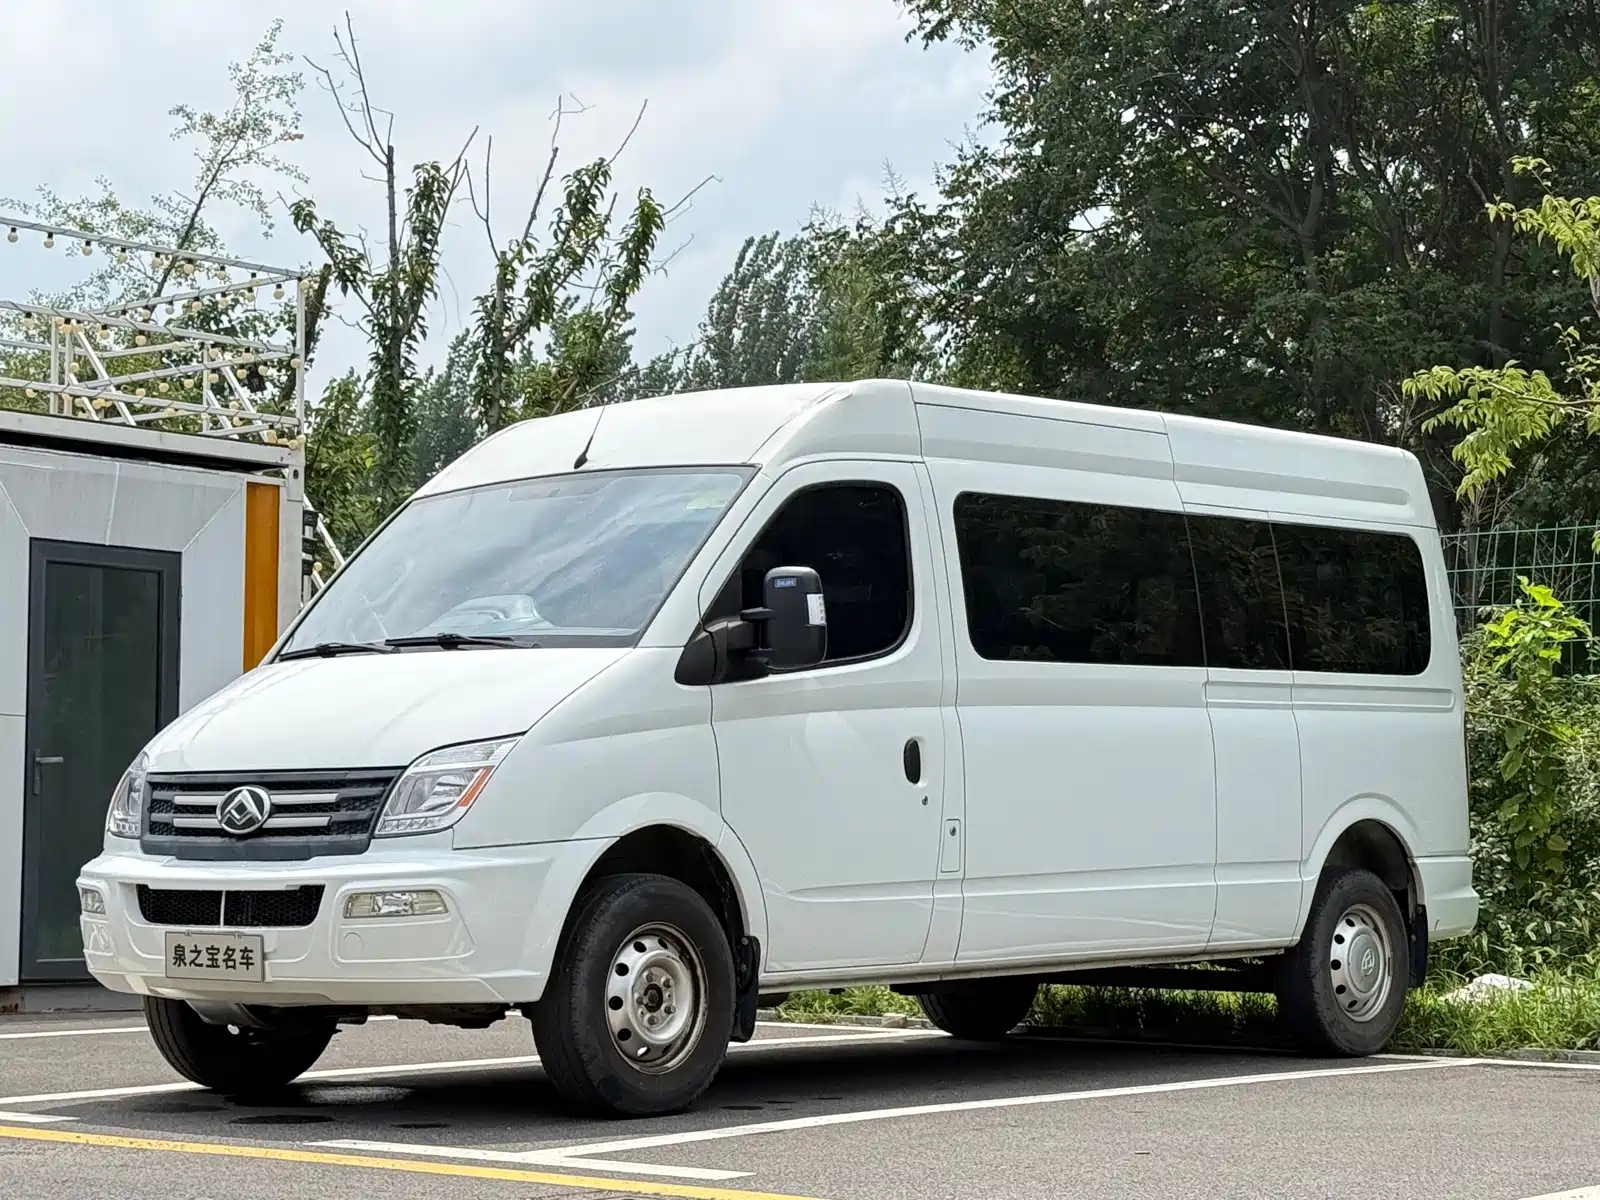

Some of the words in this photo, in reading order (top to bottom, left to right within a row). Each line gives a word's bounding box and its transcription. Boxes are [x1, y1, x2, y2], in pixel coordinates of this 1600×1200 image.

[172, 943, 255, 971] 泉之宝名车
